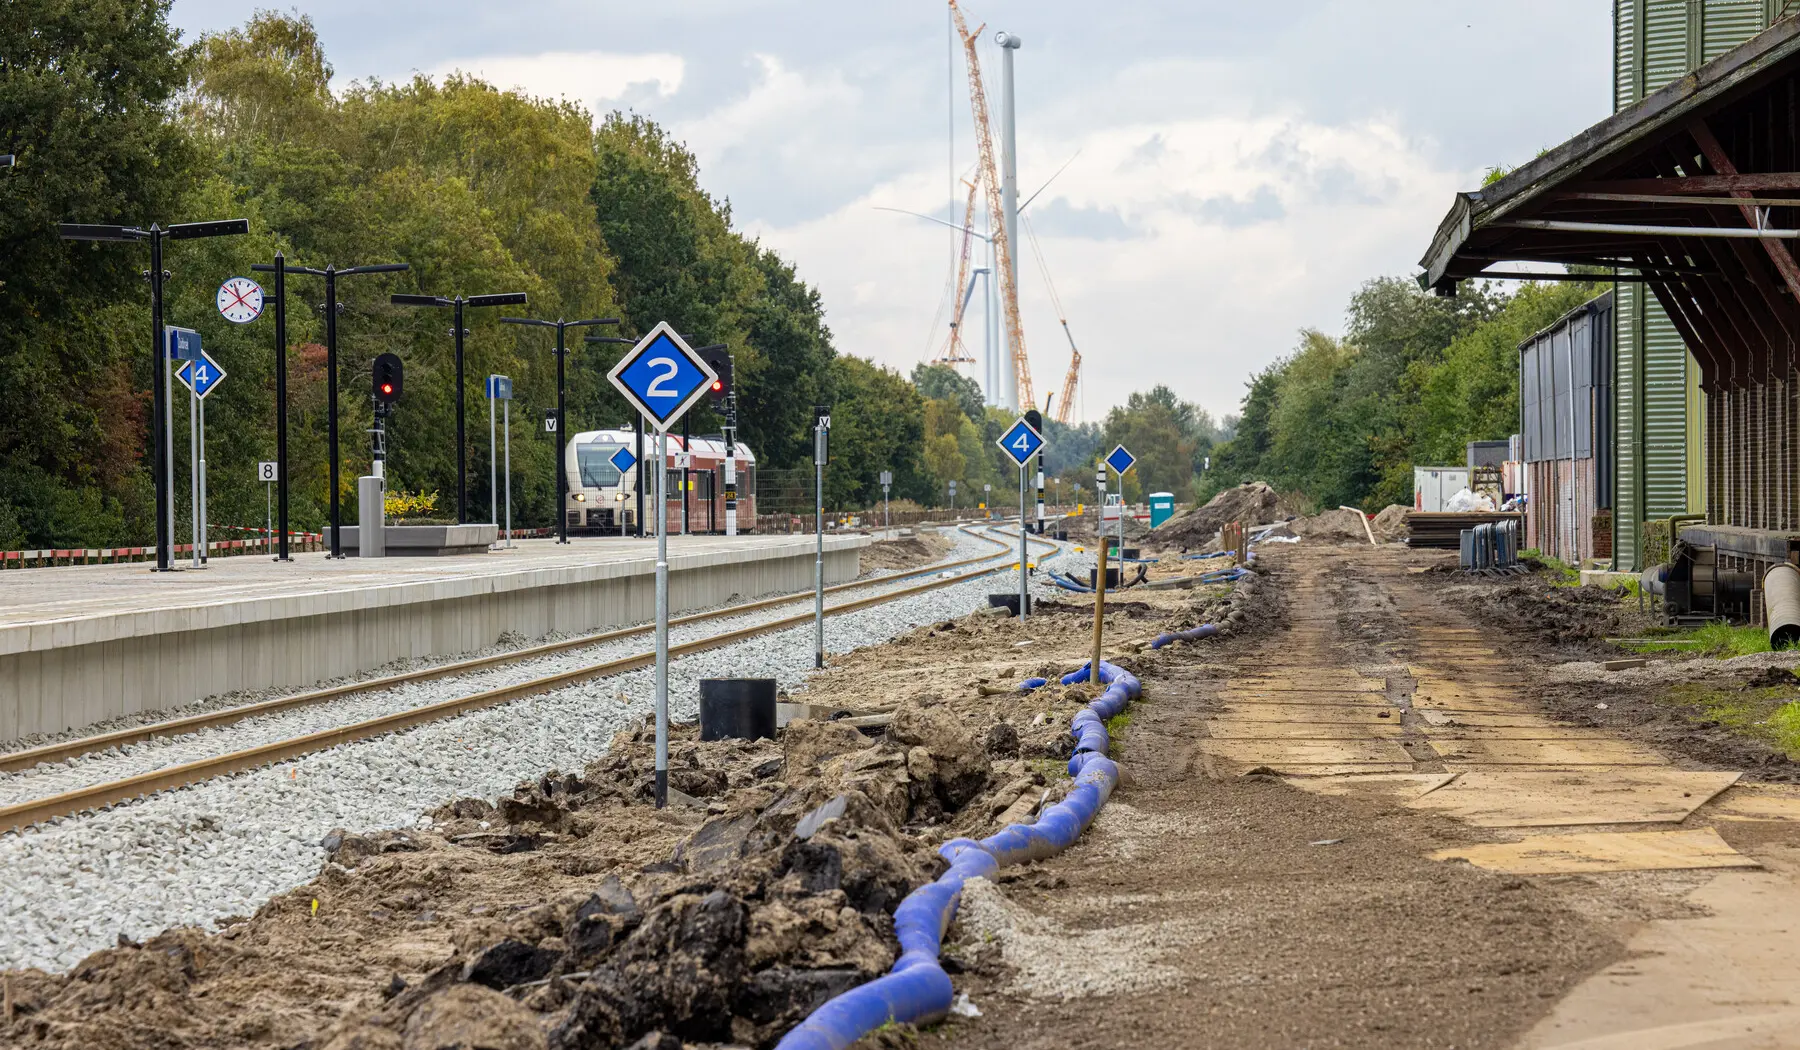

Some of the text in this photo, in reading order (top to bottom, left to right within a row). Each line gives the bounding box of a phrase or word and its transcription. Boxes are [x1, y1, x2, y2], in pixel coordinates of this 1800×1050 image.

[196, 366, 209, 384] 4
[647, 358, 678, 397] 2
[547, 420, 556, 429] V
[821, 418, 829, 427] V
[1012, 433, 1030, 452] 4
[264, 464, 273, 478] 8
